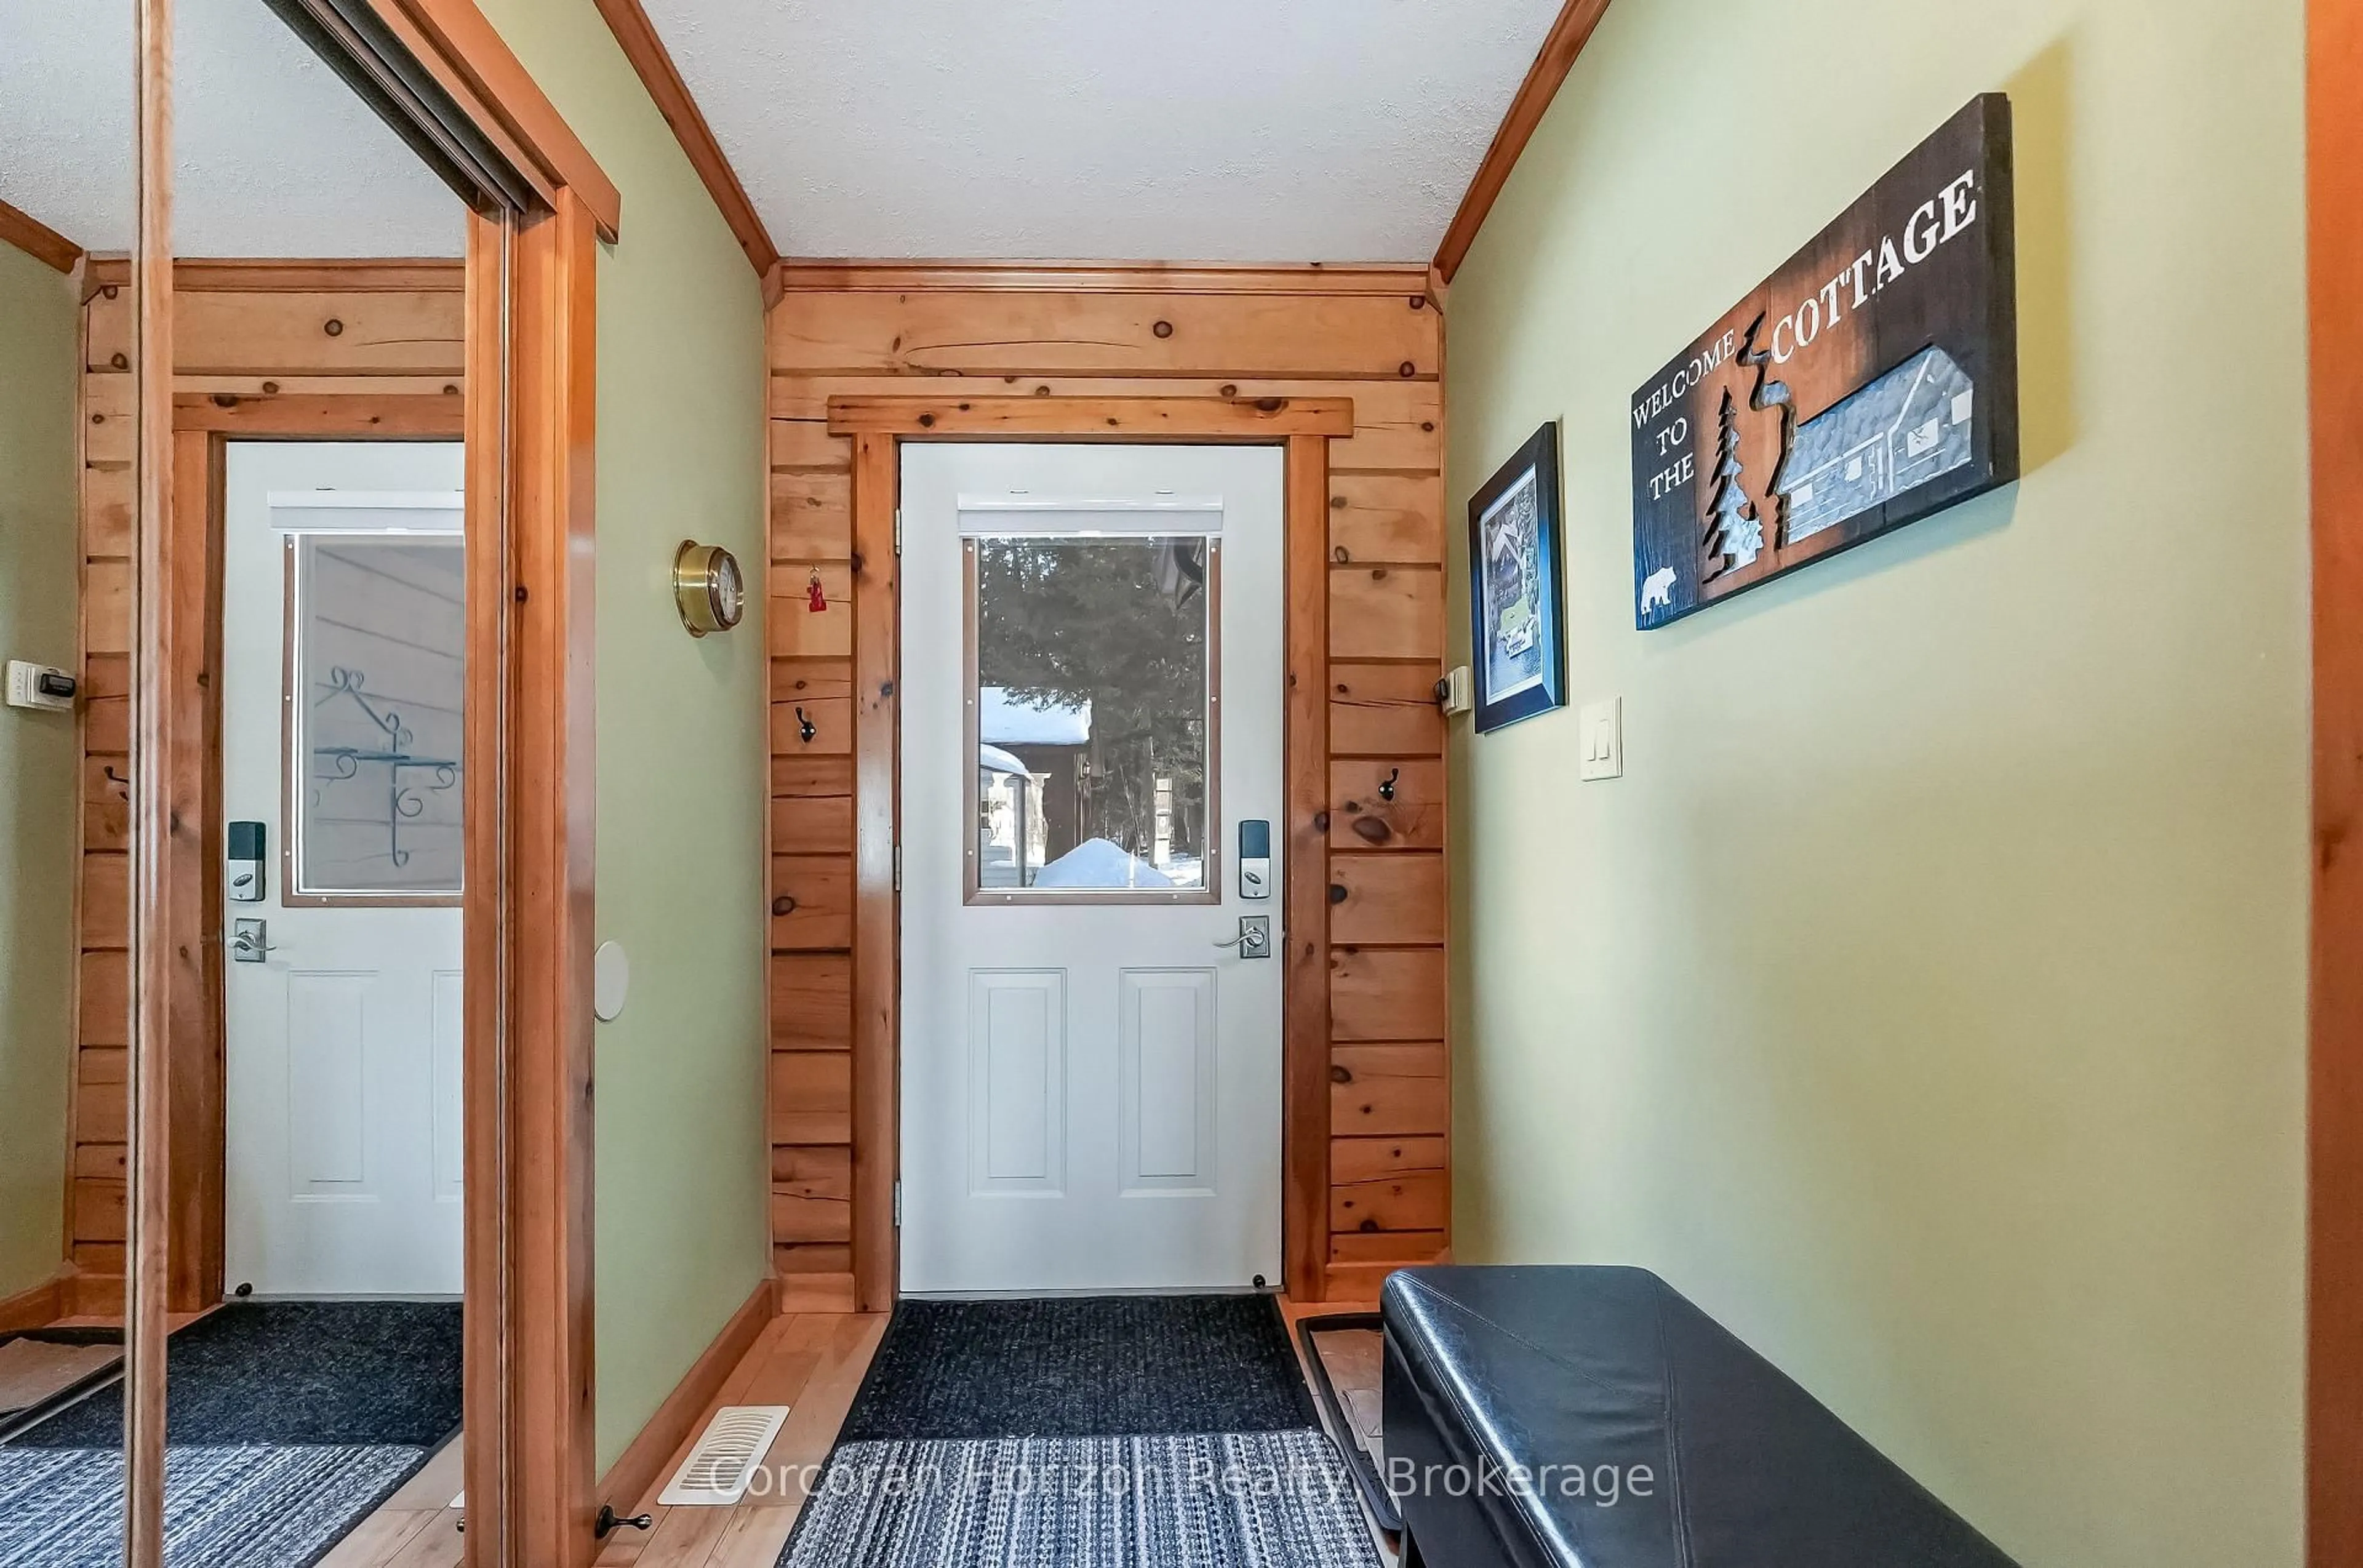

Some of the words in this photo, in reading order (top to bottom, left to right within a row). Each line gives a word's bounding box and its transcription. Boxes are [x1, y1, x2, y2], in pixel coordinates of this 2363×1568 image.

[1770, 169, 1977, 365] COTTAGE
[1633, 328, 1736, 430] WELCOME
[1656, 417, 1687, 457] TO
[1649, 452, 1695, 500] THE
